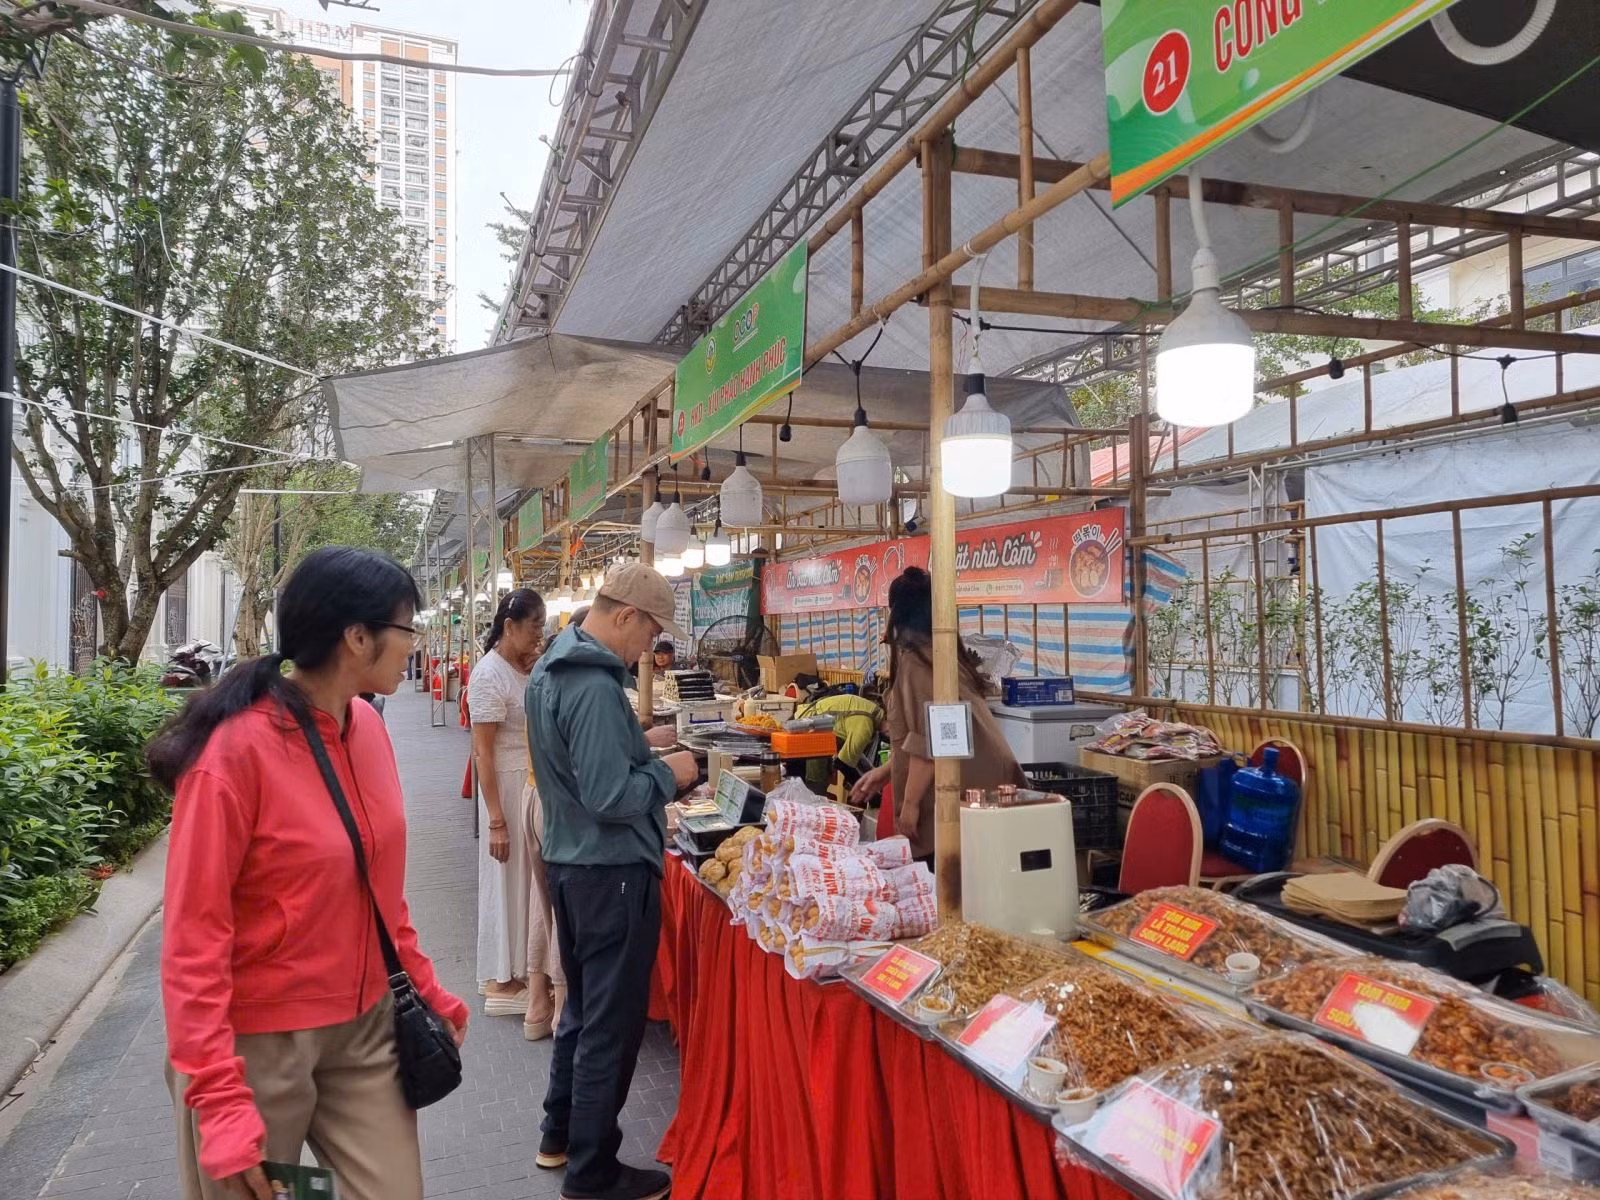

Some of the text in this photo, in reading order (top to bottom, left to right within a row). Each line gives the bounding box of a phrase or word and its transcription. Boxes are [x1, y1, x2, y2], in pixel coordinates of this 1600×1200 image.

[1151, 49, 1179, 97] 21
[971, 541, 1000, 569] nhà
[1002, 534, 1036, 567] Cốm
[1354, 980, 1384, 1001] TÔM
